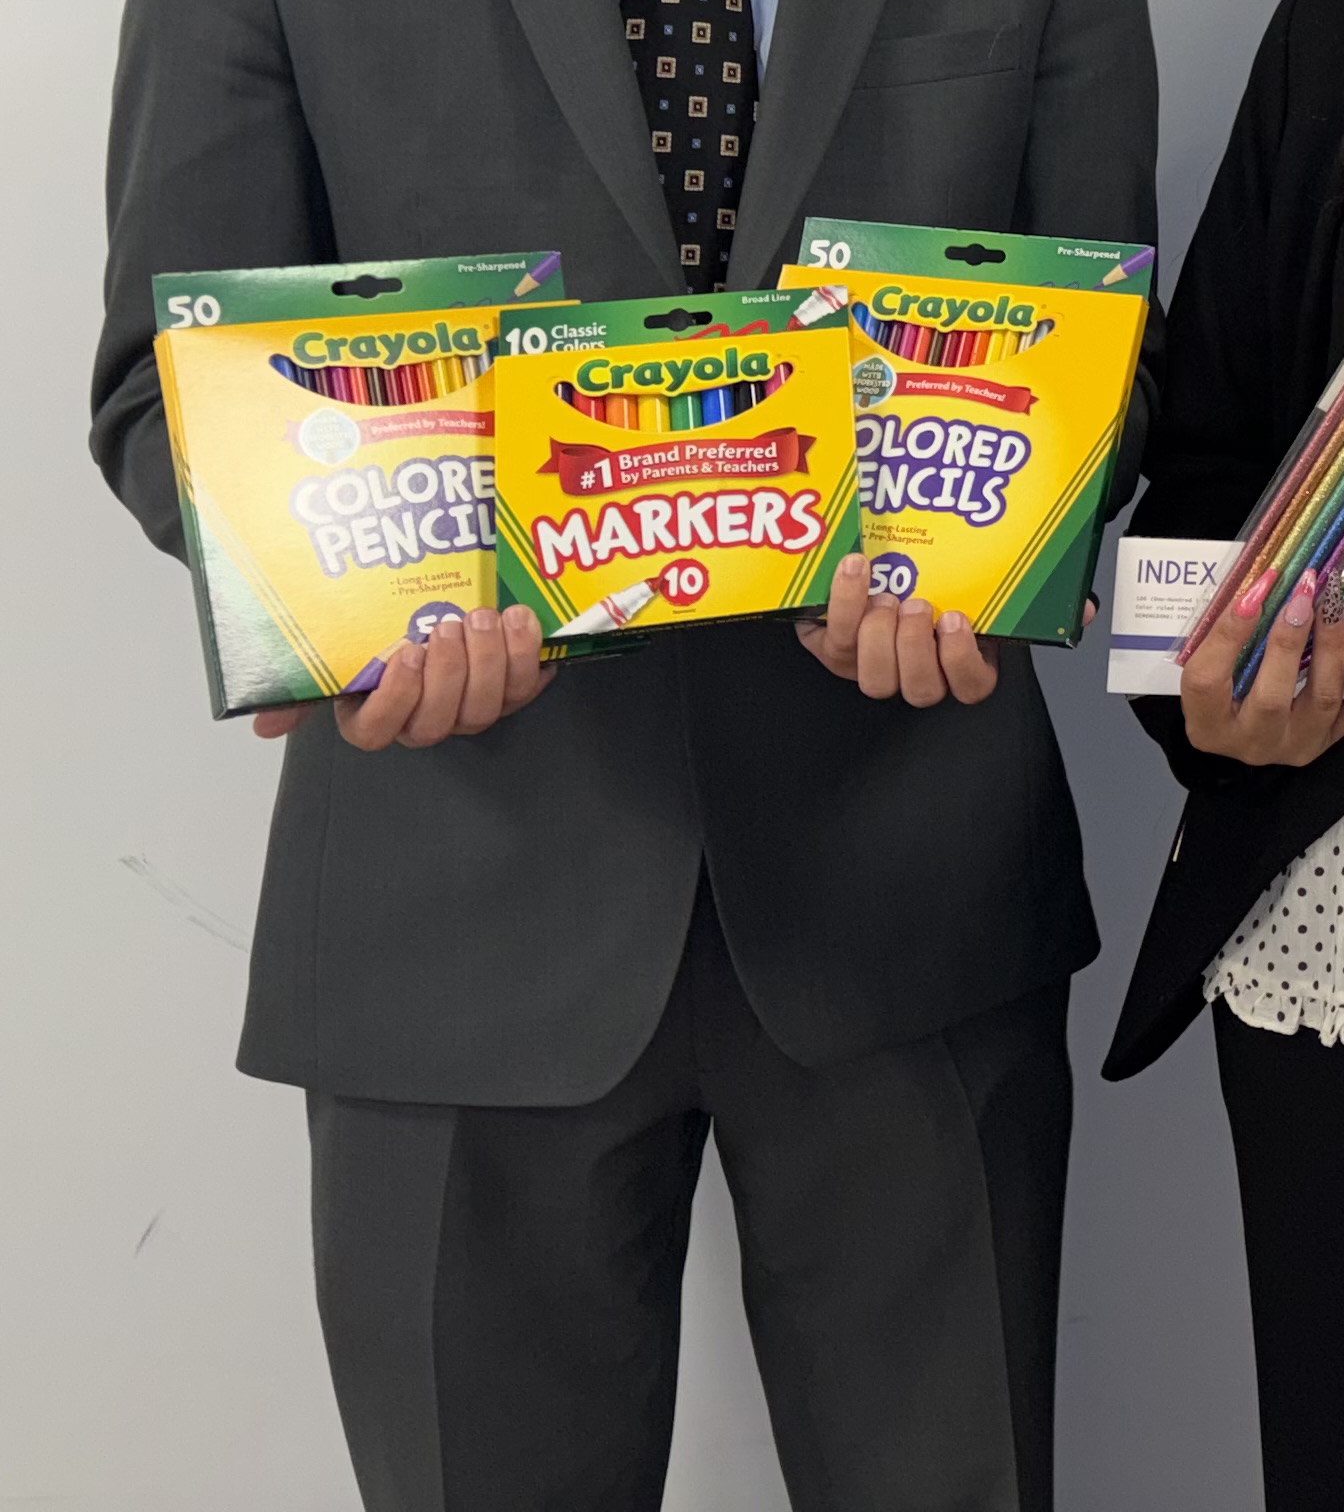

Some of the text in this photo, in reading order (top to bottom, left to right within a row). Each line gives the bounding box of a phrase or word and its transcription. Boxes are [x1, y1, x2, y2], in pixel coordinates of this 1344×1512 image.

[458, 260, 526, 273] Pre-Sharpened
[808, 239, 851, 268] 50
[1057, 246, 1121, 260] Pre-Sharpened
[168, 294, 220, 329] 50
[741, 295, 769, 304] Broad
[871, 286, 1035, 328] Crayola
[292, 322, 483, 369] Crayola
[505, 327, 548, 356] 10
[551, 322, 607, 339] Classic
[551, 339, 605, 353] Colors
[576, 347, 771, 392] Crayola
[906, 380, 1006, 402] Preferred by Teachers!
[855, 419, 1026, 472] OLORED
[580, 442, 777, 490] #1 Brand Preferred
[621, 460, 779, 485] by Parents & Teachers
[296, 461, 495, 525] COLORE
[858, 462, 1004, 522] ENCILS
[316, 504, 496, 573] PENCIL
[535, 491, 821, 575] MARKERS
[664, 566, 704, 596] 10
[868, 563, 912, 596] 50
[1137, 559, 1218, 585] INDEX
